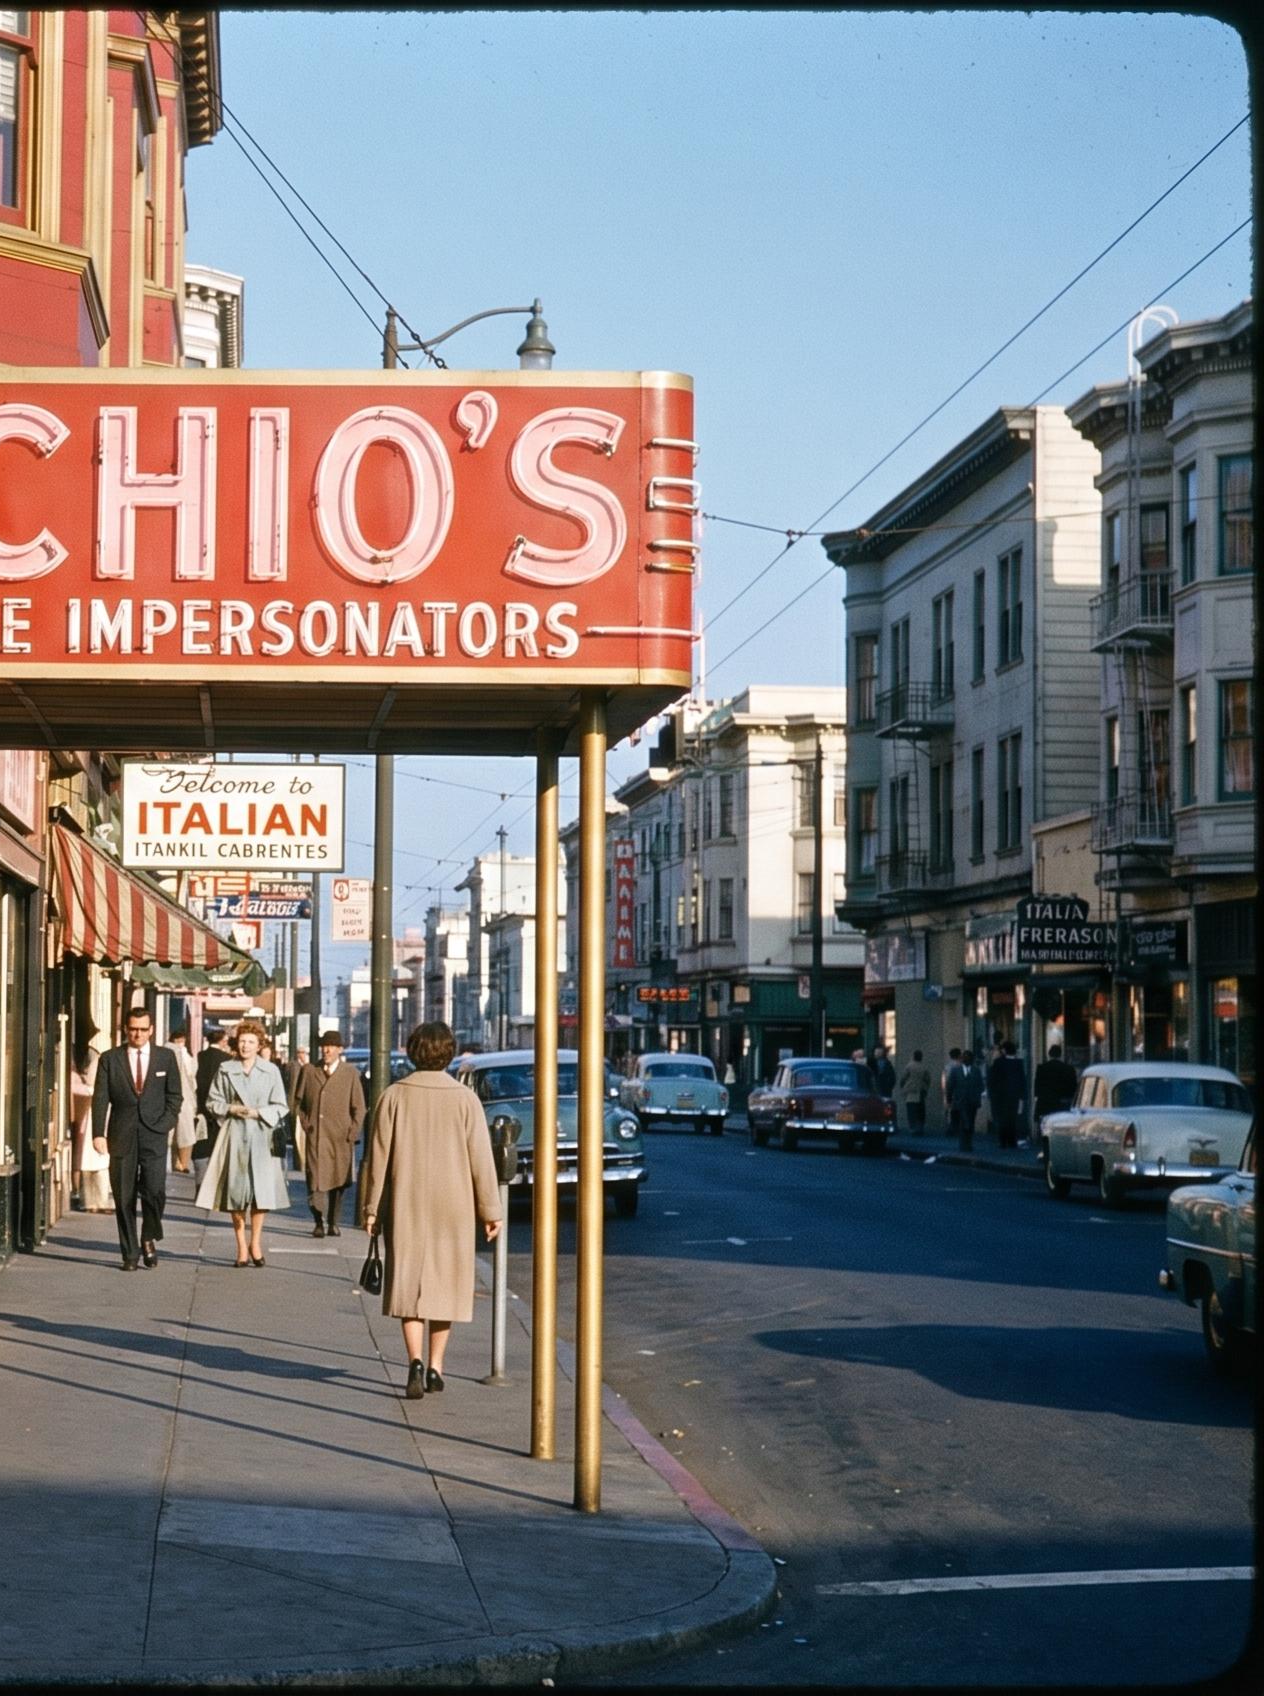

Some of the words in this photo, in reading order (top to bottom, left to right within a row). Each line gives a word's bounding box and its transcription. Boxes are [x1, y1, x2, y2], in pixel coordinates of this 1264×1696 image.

[67, 598, 581, 660] IMPERSONATORS
[289, 776, 314, 794] to
[138, 801, 328, 837] ITALIAN
[135, 842, 208, 858] ITANKIL
[218, 843, 328, 859] CABRENTES
[1025, 902, 1085, 920] ITALIA
